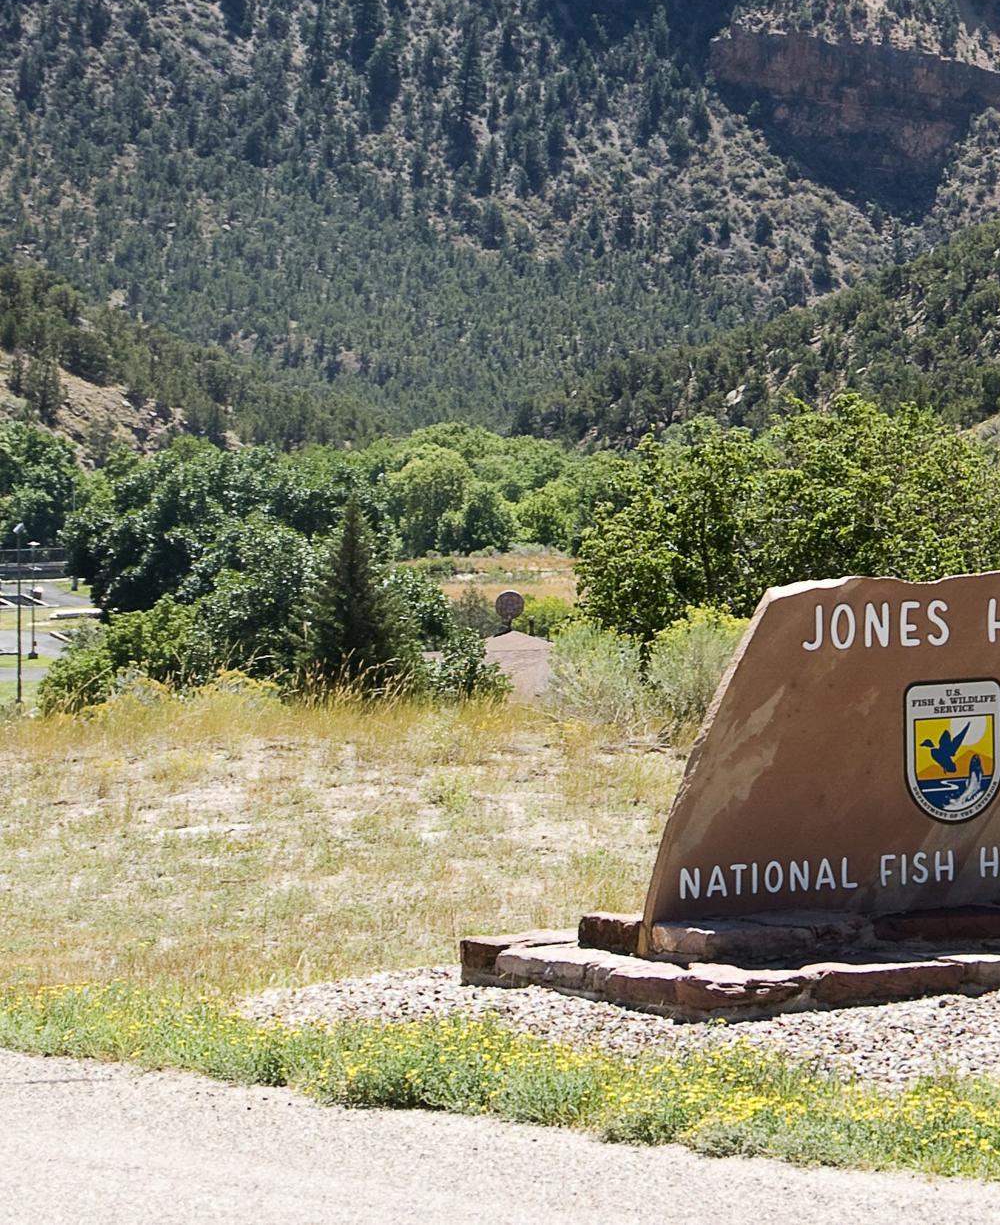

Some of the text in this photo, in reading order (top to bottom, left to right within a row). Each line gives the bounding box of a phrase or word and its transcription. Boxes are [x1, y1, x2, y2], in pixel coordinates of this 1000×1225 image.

[802, 599, 950, 651] JONES
[912, 697, 934, 707] FISH
[950, 694, 996, 705] WILDLIFE
[945, 689, 962, 697] U.S.
[933, 704, 975, 714] SERVICE
[913, 785, 948, 818] DEPARTMENT
[678, 856, 858, 901] NATIONAL
[879, 850, 954, 887] FISH
